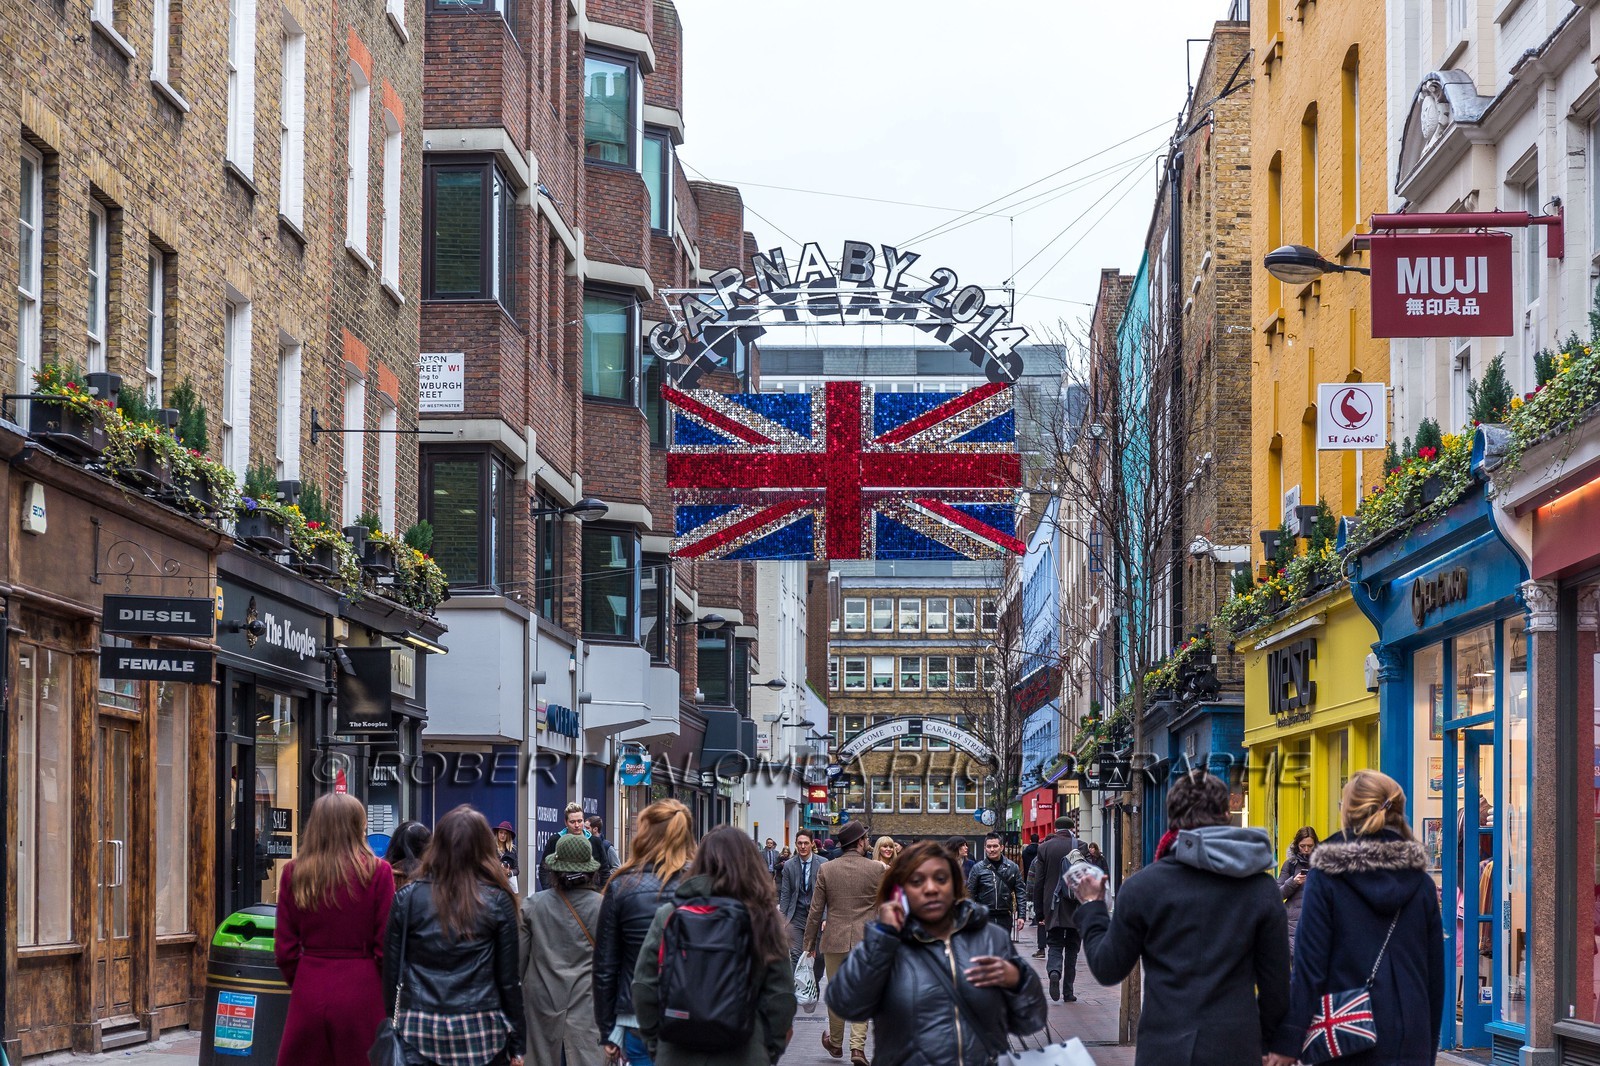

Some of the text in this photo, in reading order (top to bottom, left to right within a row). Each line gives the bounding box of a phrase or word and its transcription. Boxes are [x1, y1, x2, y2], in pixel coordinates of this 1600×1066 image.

[1397, 256, 1489, 295] MUJI
[648, 239, 1030, 361] CARNABY 2014
[1405, 297, 1480, 316] 無印良品
[119, 609, 196, 623] DIESEL
[264, 612, 317, 661] The Kooples
[118, 657, 195, 673] FEMALE
[847, 730, 886, 755] WELCOME
[891, 724, 903, 733] TO
[925, 723, 963, 743] CARNABY
[272, 810, 287, 829] SALE
